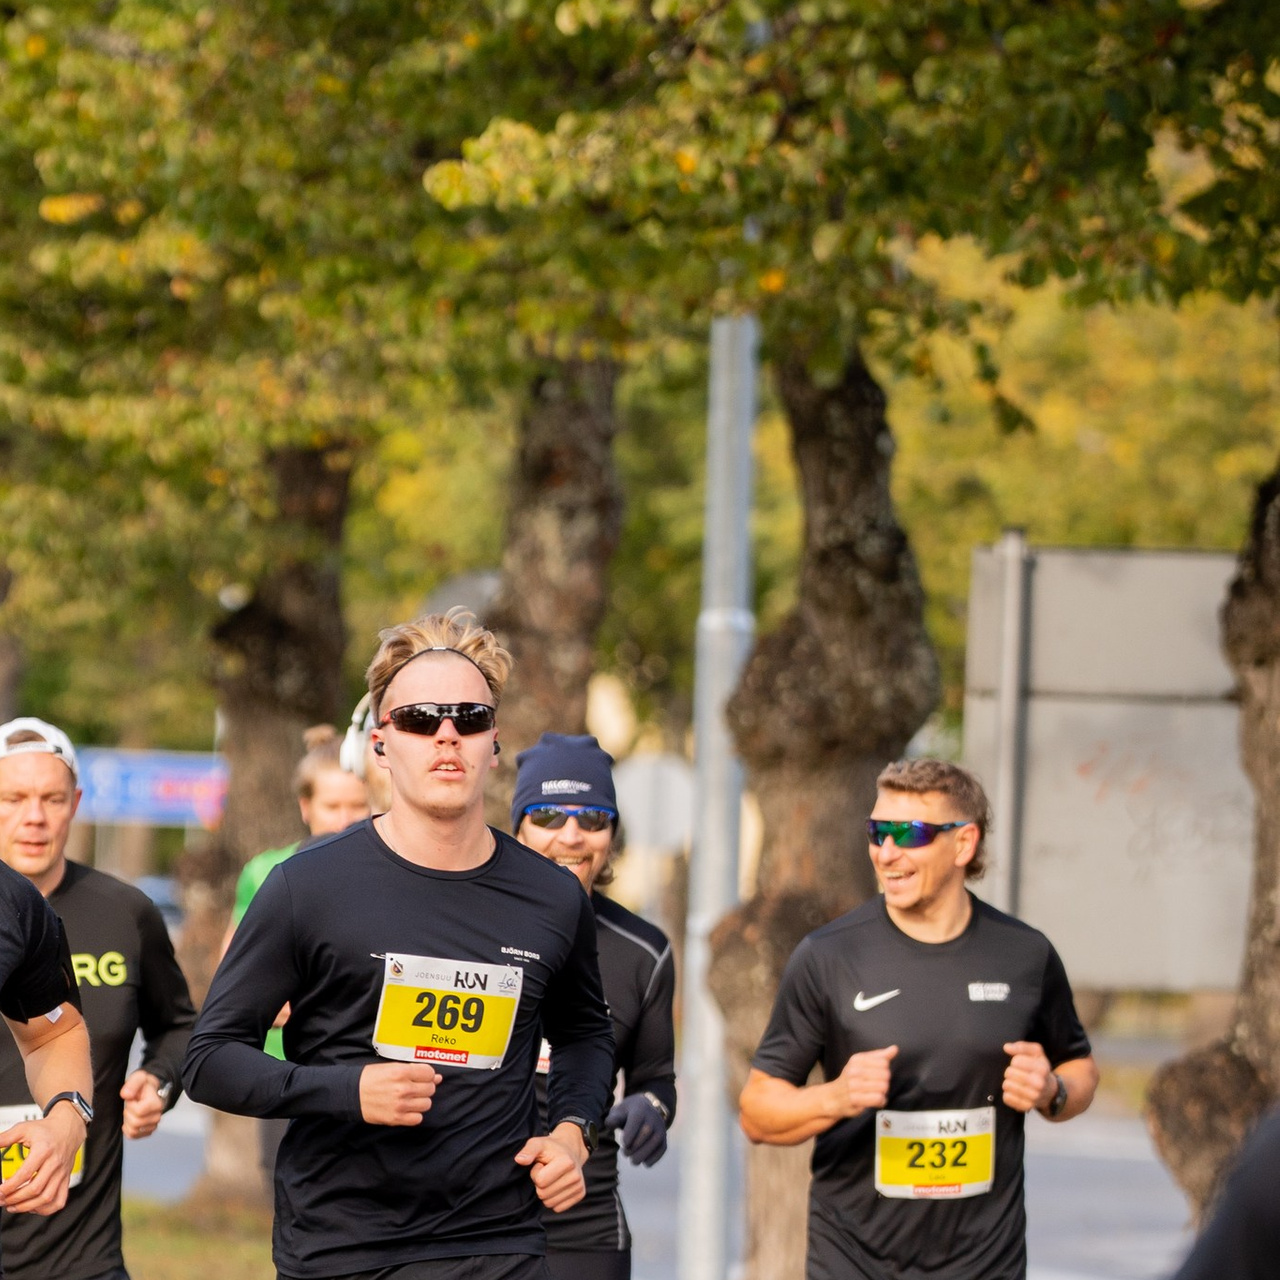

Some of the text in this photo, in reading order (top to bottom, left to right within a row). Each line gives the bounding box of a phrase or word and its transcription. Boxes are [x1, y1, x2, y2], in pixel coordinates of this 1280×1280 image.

[415, 973, 452, 982] JOENSUU
[454, 970, 488, 991] RUN
[411, 991, 485, 1033] 269
[431, 1033, 457, 1045] Reko
[416, 1049, 467, 1062] motonet
[907, 1140, 968, 1168] 232
